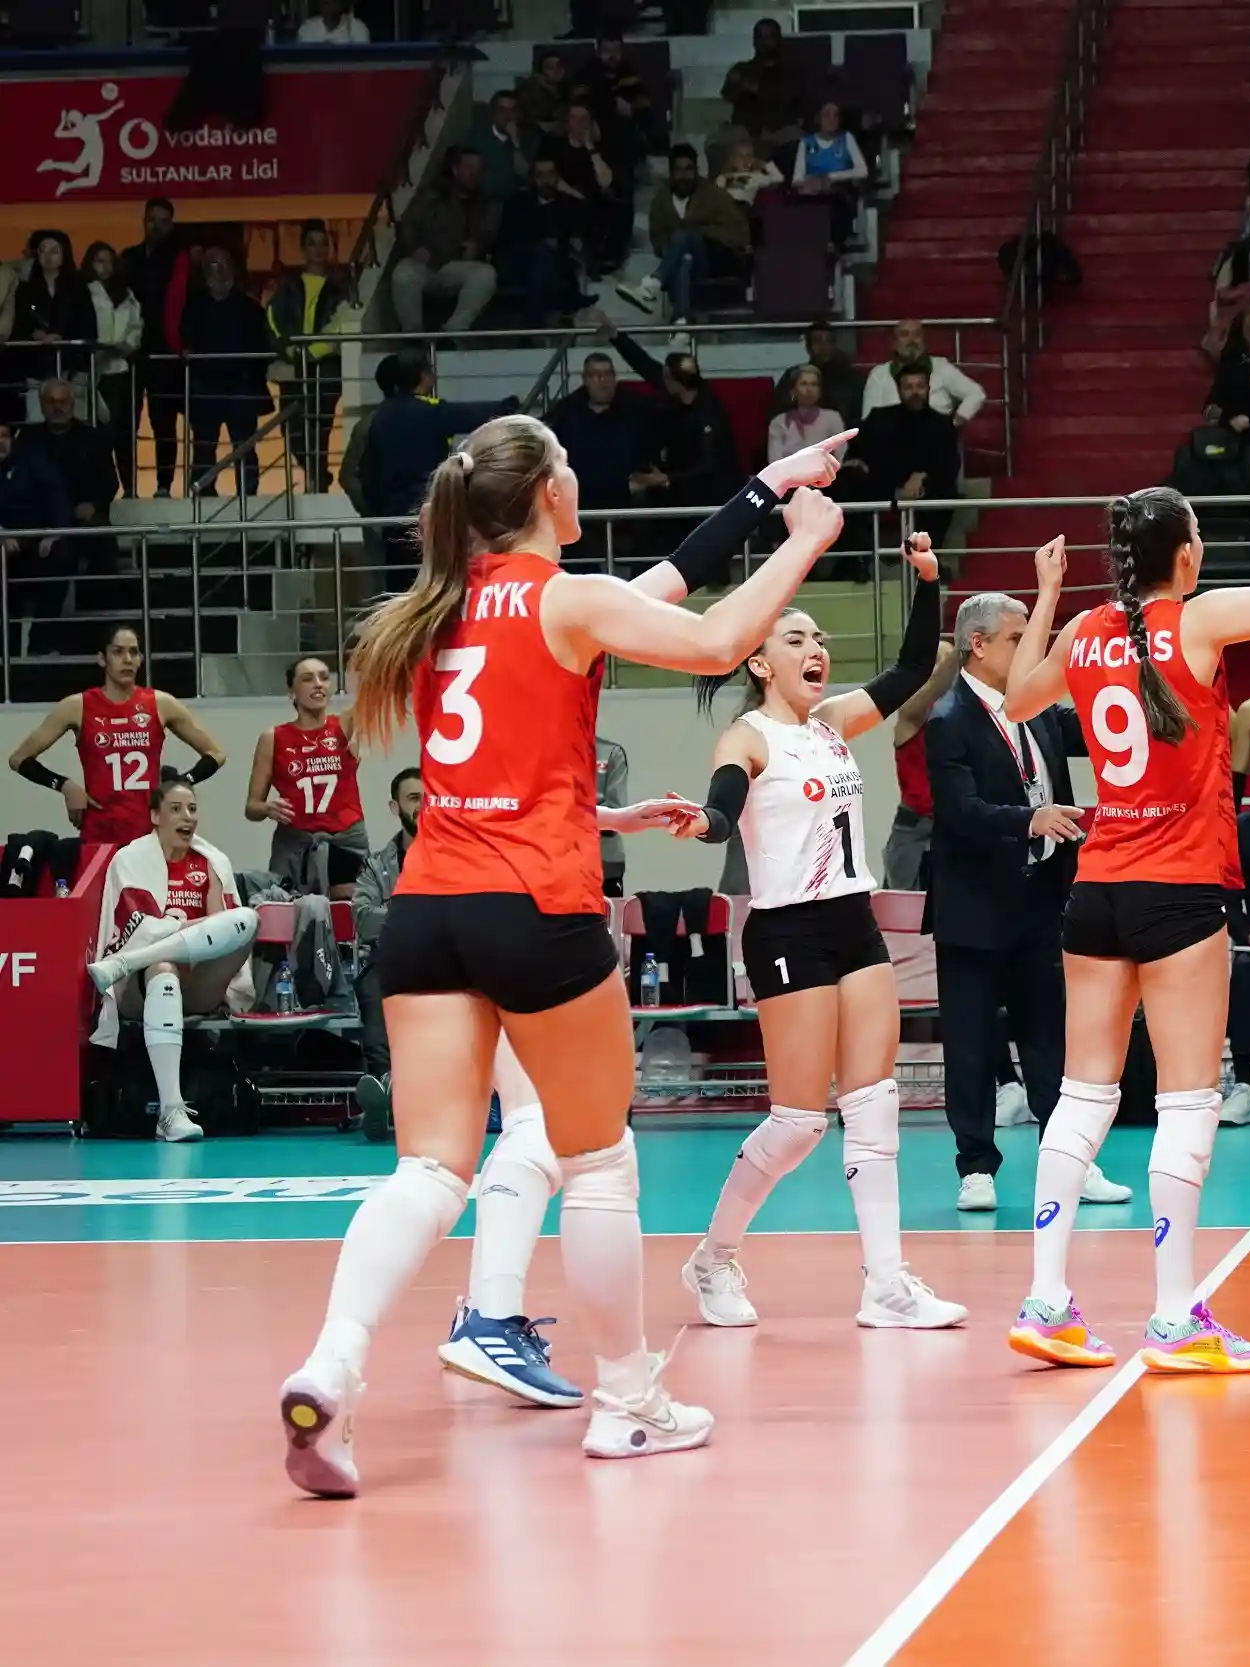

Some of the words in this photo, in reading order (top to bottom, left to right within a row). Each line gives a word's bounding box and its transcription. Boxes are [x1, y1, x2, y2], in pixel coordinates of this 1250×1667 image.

[165, 124, 277, 148] vodafone
[120, 165, 232, 184] SULTANLAR
[242, 158, 278, 180] LİGİ
[475, 582, 533, 621] RYK
[425, 645, 487, 765] 3
[112, 731, 150, 740] TURKISH
[112, 739, 150, 747] AIRLINES
[1092, 685, 1150, 787] 9
[105, 751, 150, 791] 12
[296, 774, 338, 815] 17
[1102, 806, 1140, 819] TURKISH
[1142, 803, 1187, 818] AIRLINES
[832, 810, 857, 878] 1
[774, 956, 790, 985] 1
